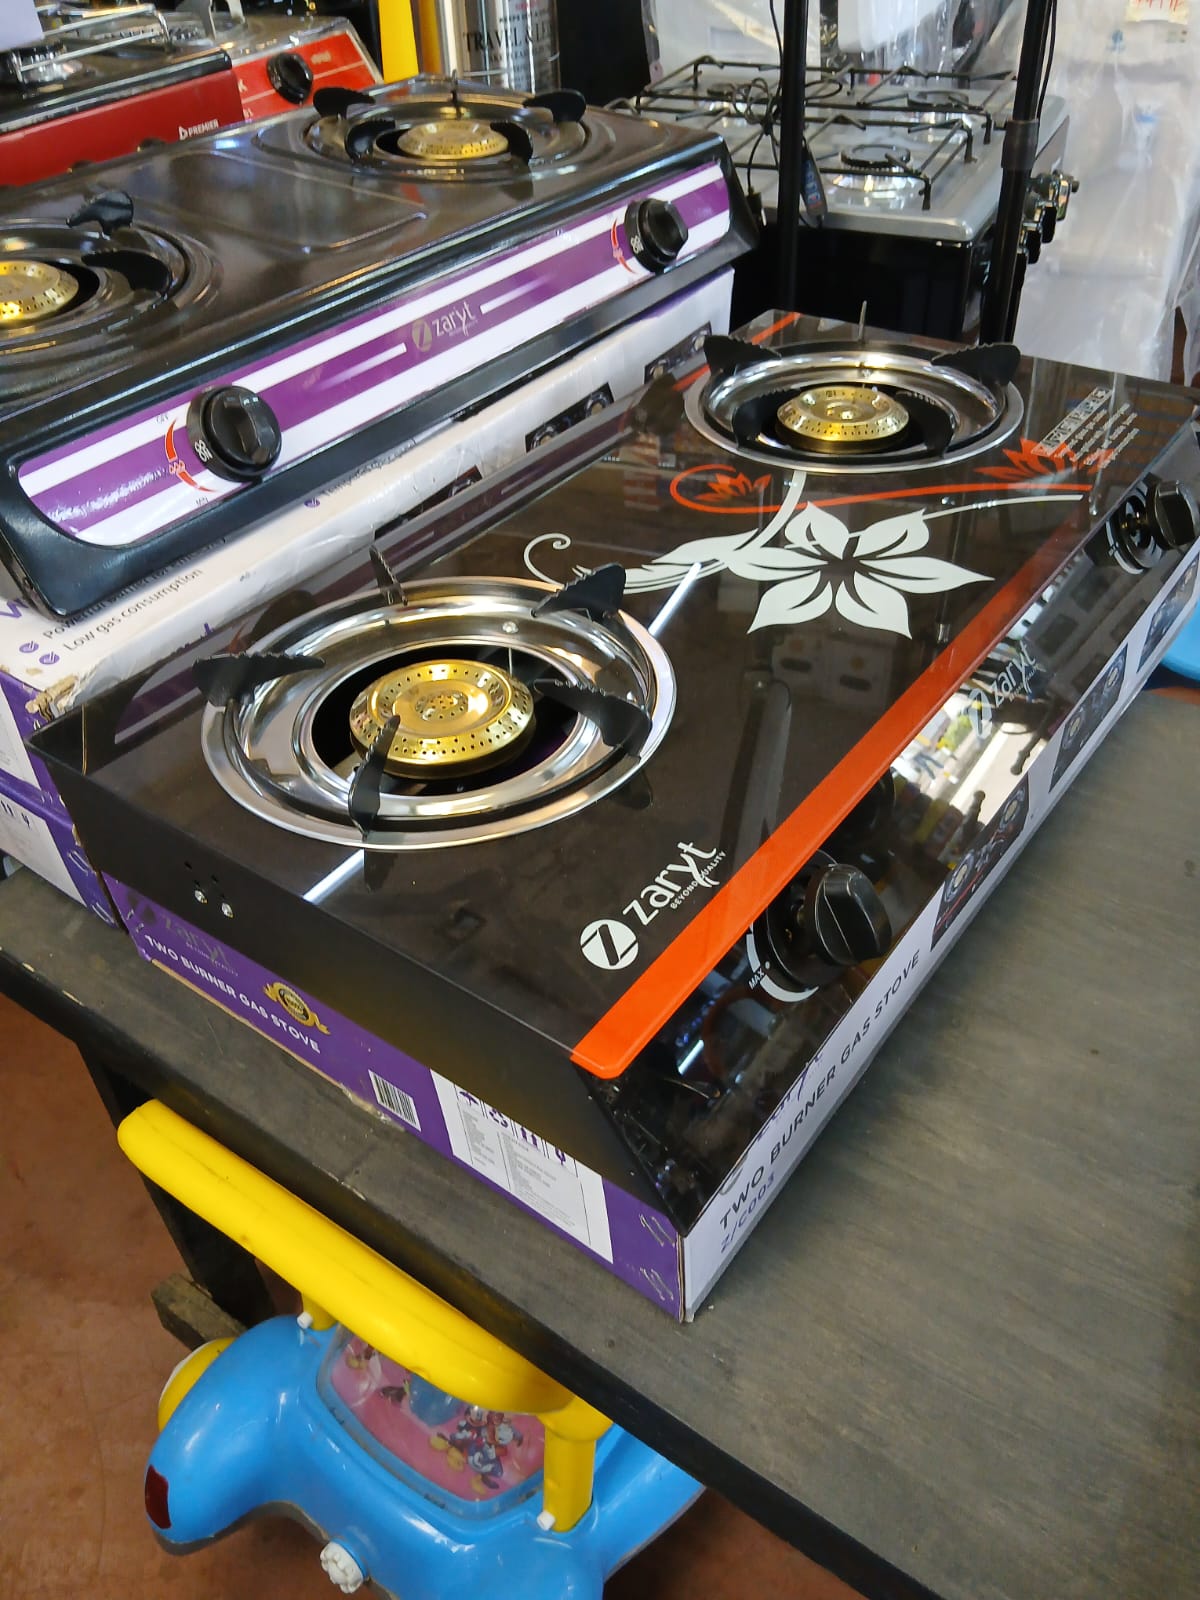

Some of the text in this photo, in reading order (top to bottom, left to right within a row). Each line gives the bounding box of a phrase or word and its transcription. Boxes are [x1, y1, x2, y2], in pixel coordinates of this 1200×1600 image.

[187, 119, 219, 137] PREMIER
[431, 300, 477, 337] zaryt
[63, 630, 95, 651] Low
[96, 616, 122, 636] gas
[121, 567, 205, 619] consumption
[622, 841, 720, 926] zaryt
[669, 880, 698, 909] BEYOND
[144, 934, 179, 961] TWO
[181, 954, 237, 999] BURNER
[239, 992, 268, 1019] GAS
[271, 1013, 321, 1054] STOVE
[748, 967, 765, 990] MAX
[719, 1166, 765, 1229] TWO
[770, 1066, 836, 1165] BURNER
[841, 1016, 870, 1065] GAS
[874, 948, 920, 1019] STOVE
